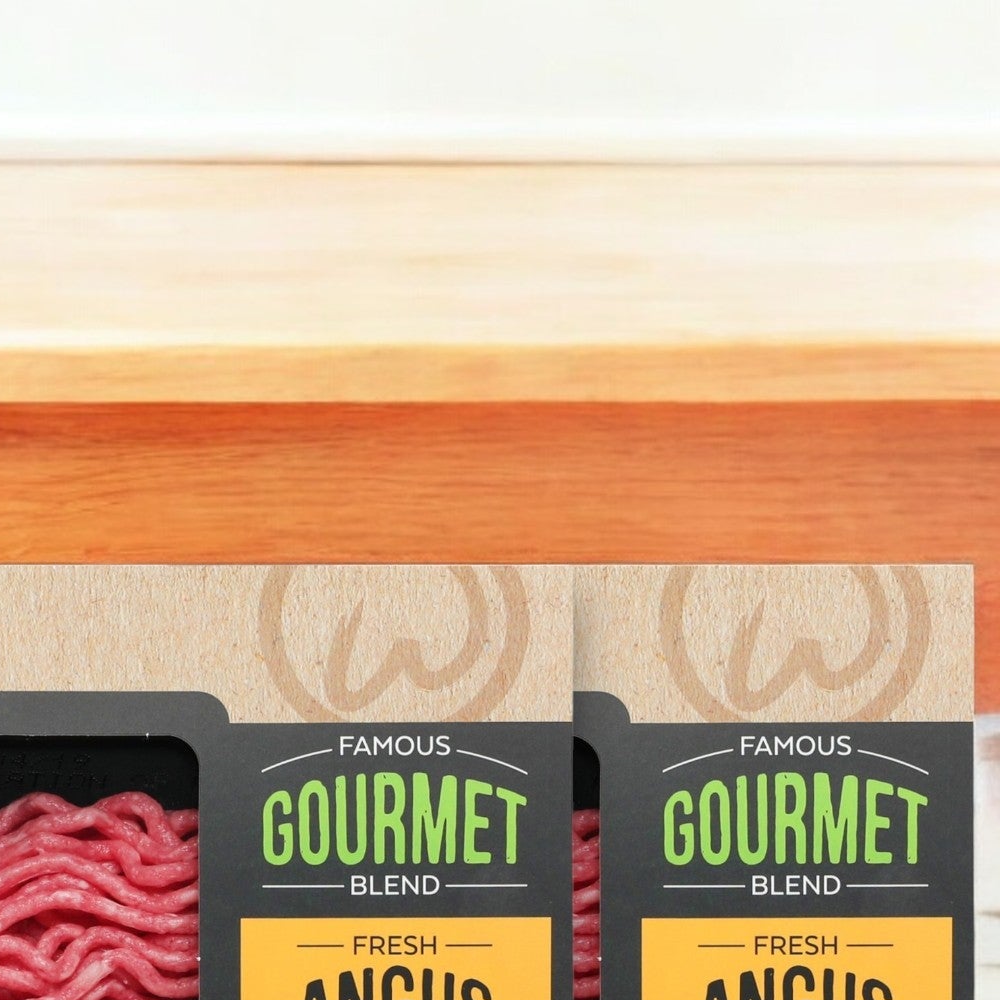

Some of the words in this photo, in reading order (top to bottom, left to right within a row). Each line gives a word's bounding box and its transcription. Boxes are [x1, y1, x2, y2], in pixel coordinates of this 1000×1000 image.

[340, 736, 450, 755] FAMOUS
[741, 736, 851, 755] FAMOUS
[263, 773, 527, 865] GOURMET
[664, 773, 928, 865] GOURMET
[351, 875, 439, 895] BLEND
[752, 875, 840, 895] BLEND
[355, 936, 435, 954] FRESH
[756, 936, 836, 954] FRESH
